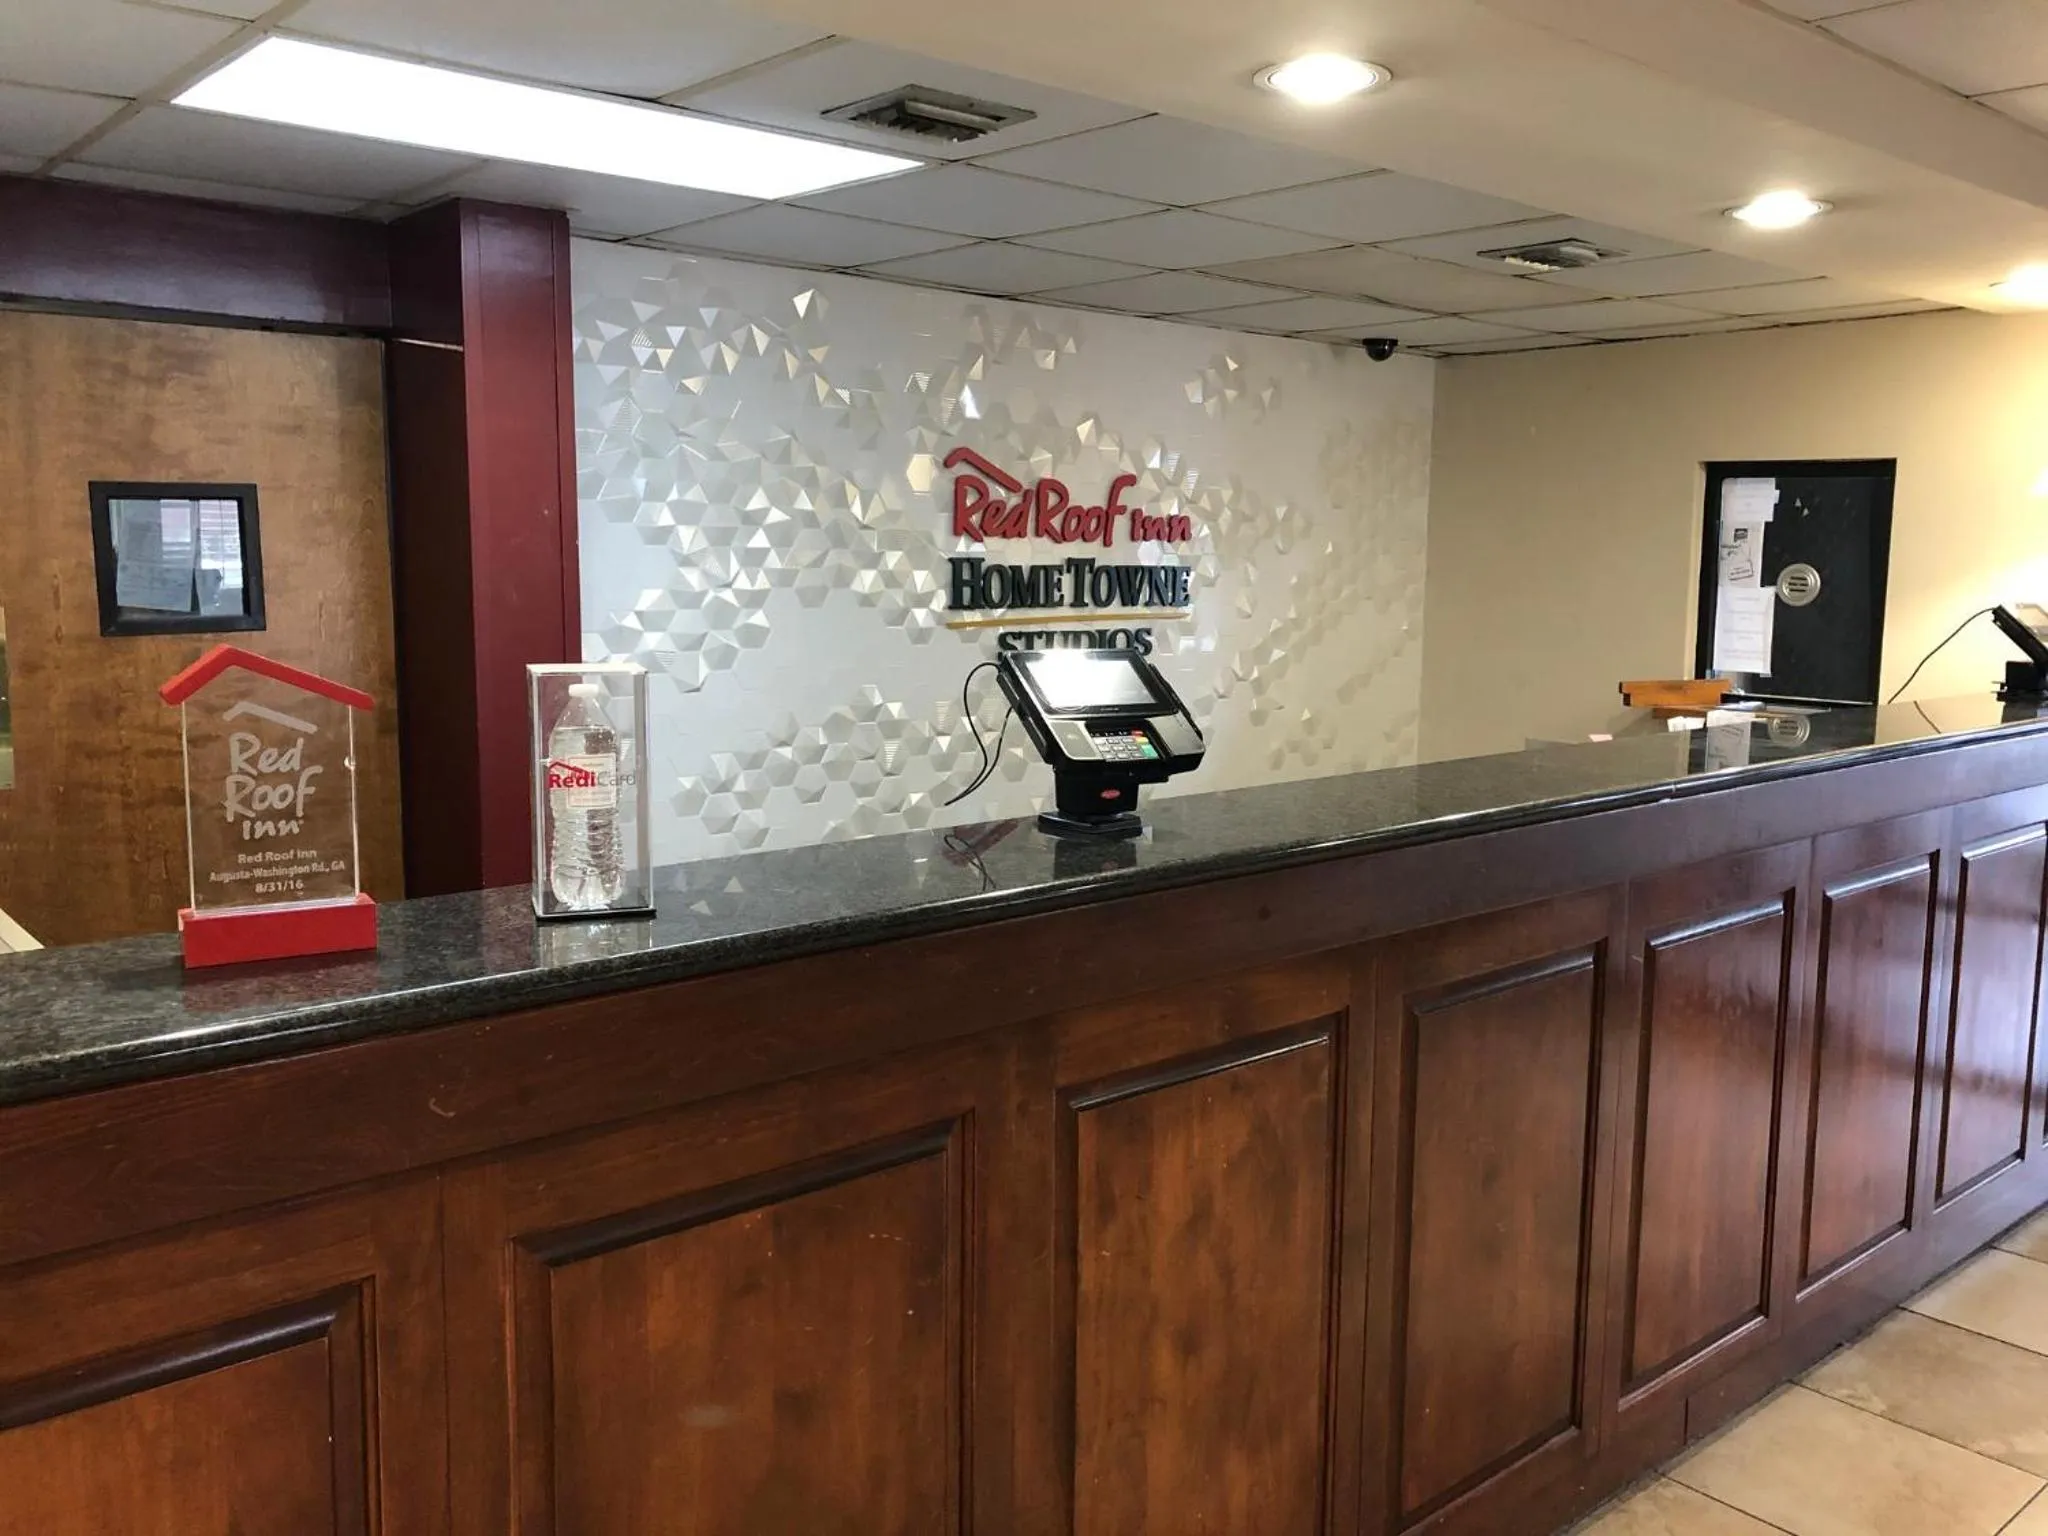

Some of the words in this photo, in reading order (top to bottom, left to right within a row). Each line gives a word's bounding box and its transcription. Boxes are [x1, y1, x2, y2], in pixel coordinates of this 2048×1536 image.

[953, 474, 1034, 542] Red
[1035, 474, 1137, 547] Roof
[229, 732, 304, 777] Red
[220, 765, 324, 822] Roof
[208, 863, 311, 883] Augusta-Washington
[331, 860, 346, 871] GA
[237, 852, 262, 864] Red
[264, 849, 295, 863] Roof
[297, 848, 318, 860] Inn
[255, 879, 305, 893] 8/31/16
